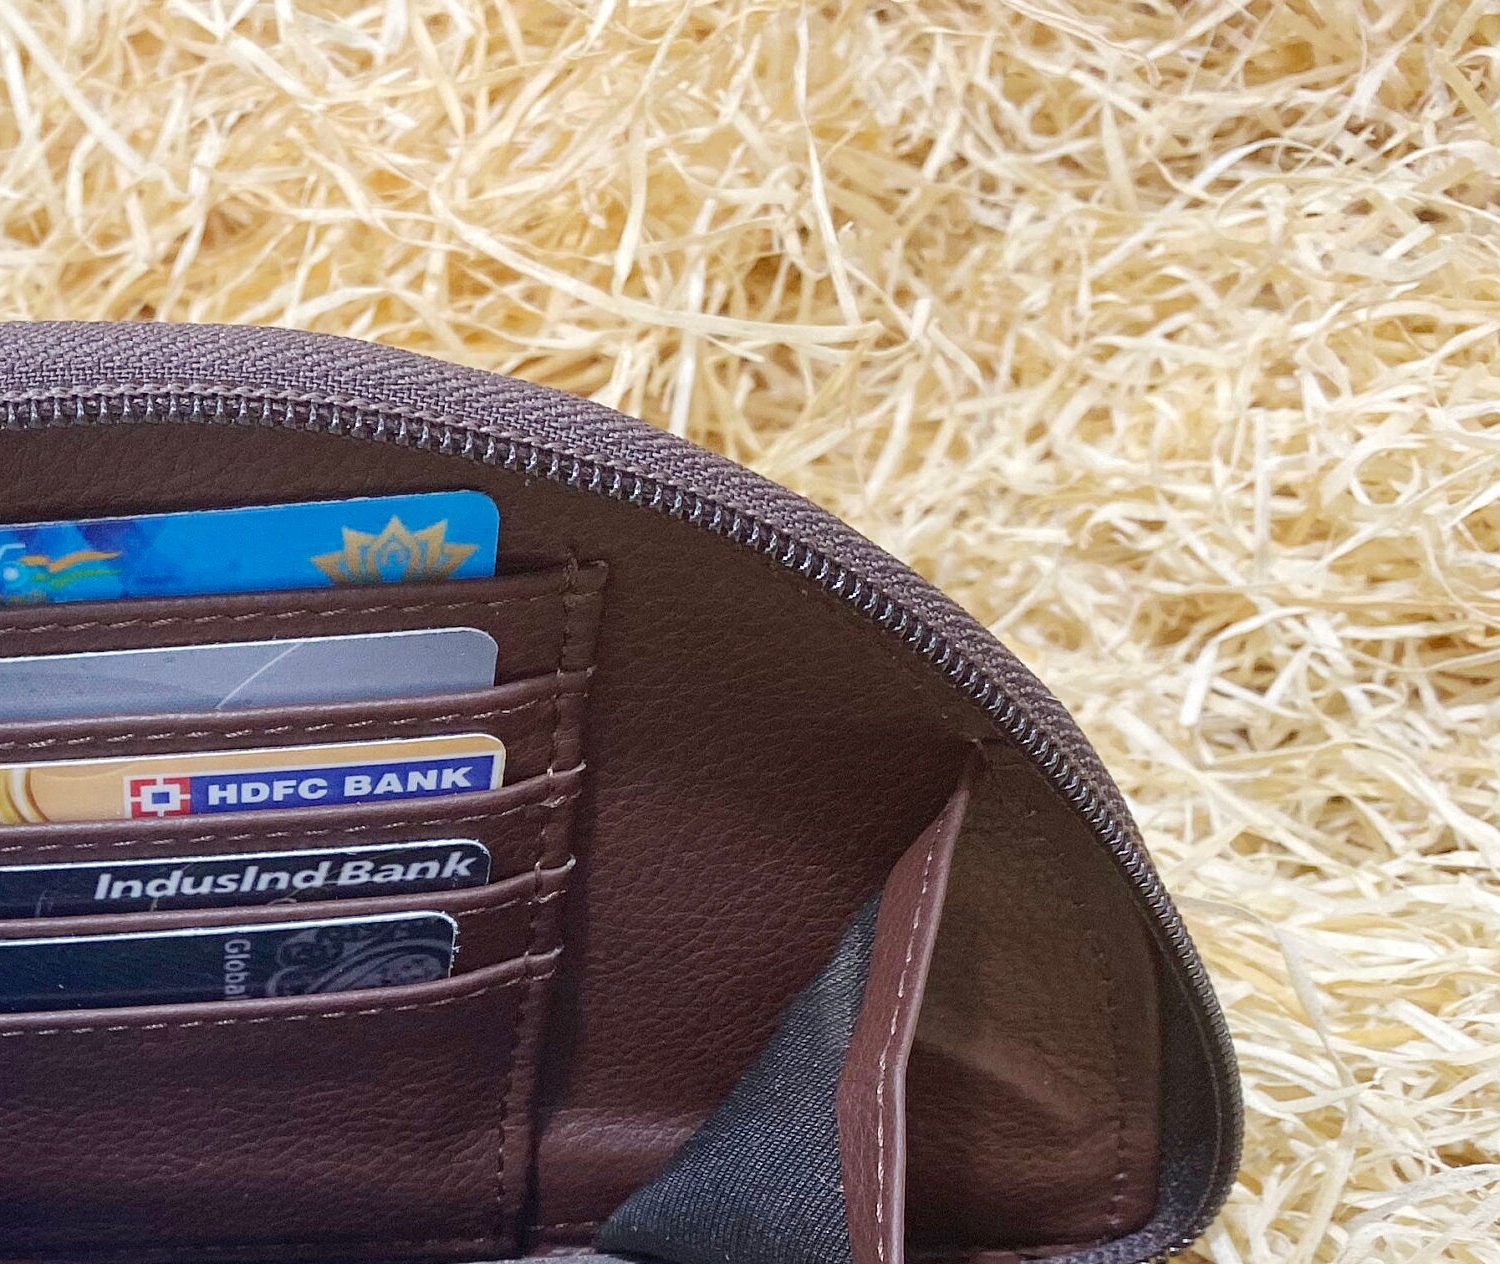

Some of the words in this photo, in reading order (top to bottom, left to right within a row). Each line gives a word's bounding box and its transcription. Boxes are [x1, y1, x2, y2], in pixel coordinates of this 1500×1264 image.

[207, 776, 329, 806] HDFC
[342, 765, 474, 797] BANK
[93, 861, 330, 901] IndusInd
[336, 851, 478, 886] Bank
